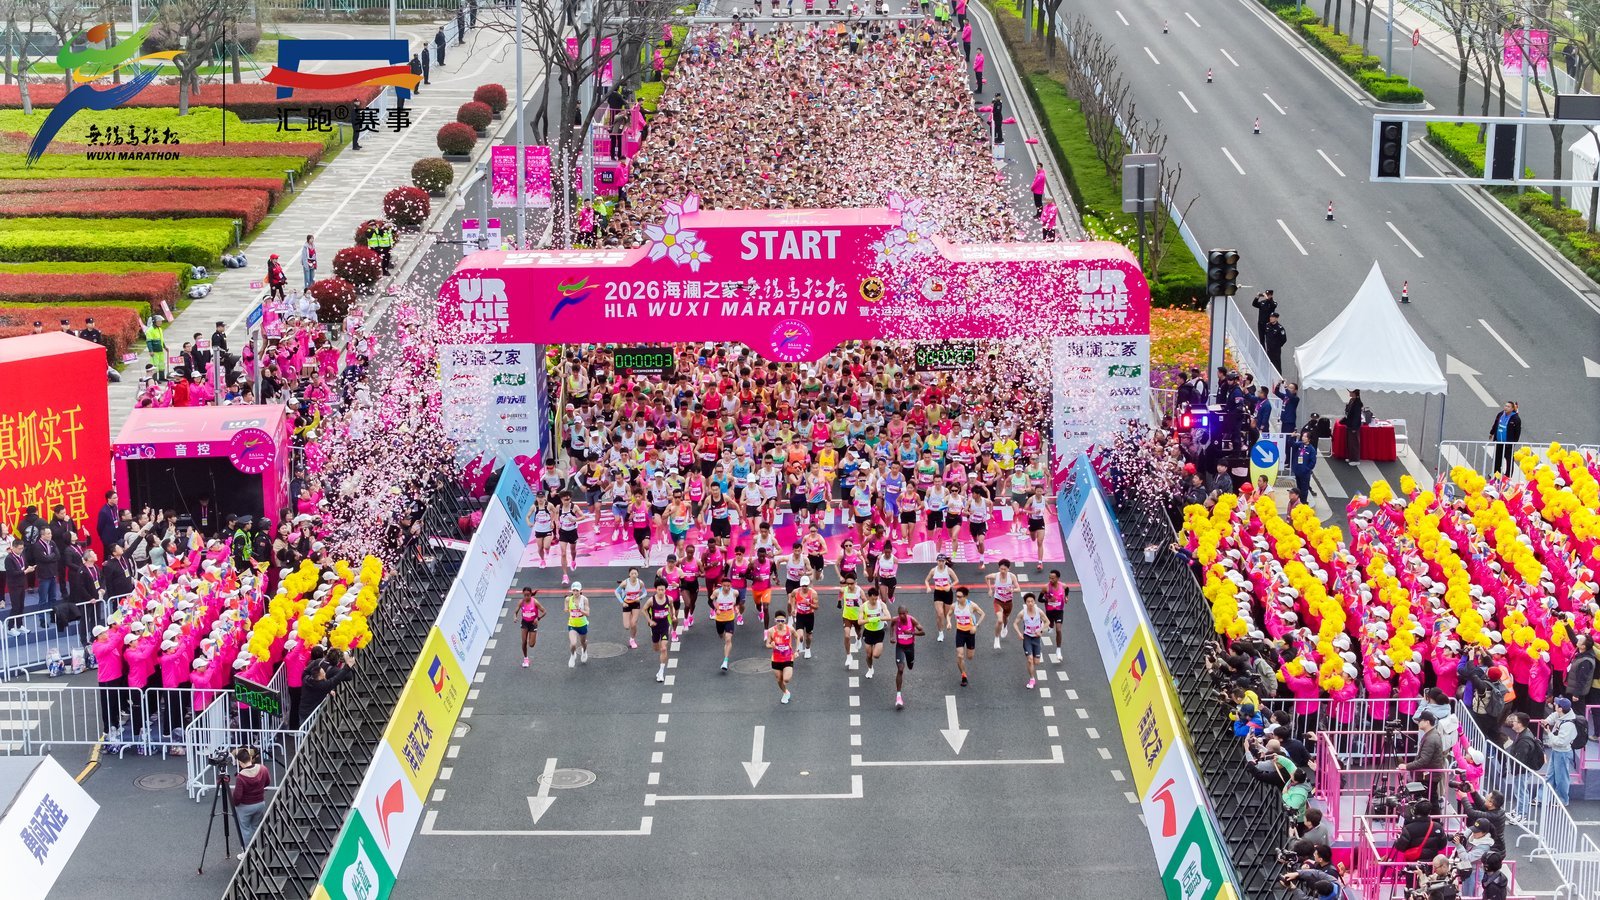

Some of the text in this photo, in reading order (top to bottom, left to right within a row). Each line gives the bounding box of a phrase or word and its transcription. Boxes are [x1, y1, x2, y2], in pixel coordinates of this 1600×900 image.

[741, 229, 841, 261] START
[458, 278, 509, 302] UR
[1077, 269, 1128, 293] UR
[460, 302, 510, 319] THE
[604, 300, 848, 318] HLA WUXI MARATHON
[1079, 293, 1128, 310] THE
[615, 354, 673, 368] 00:00:03
[0, 404, 85, 472] 真抓实干
[175, 443, 211, 456] 音控
[402, 710, 433, 778] 海澜之家
[1137, 701, 1162, 769] 海澜之家
[20, 793, 69, 866] 勇闯天涯
